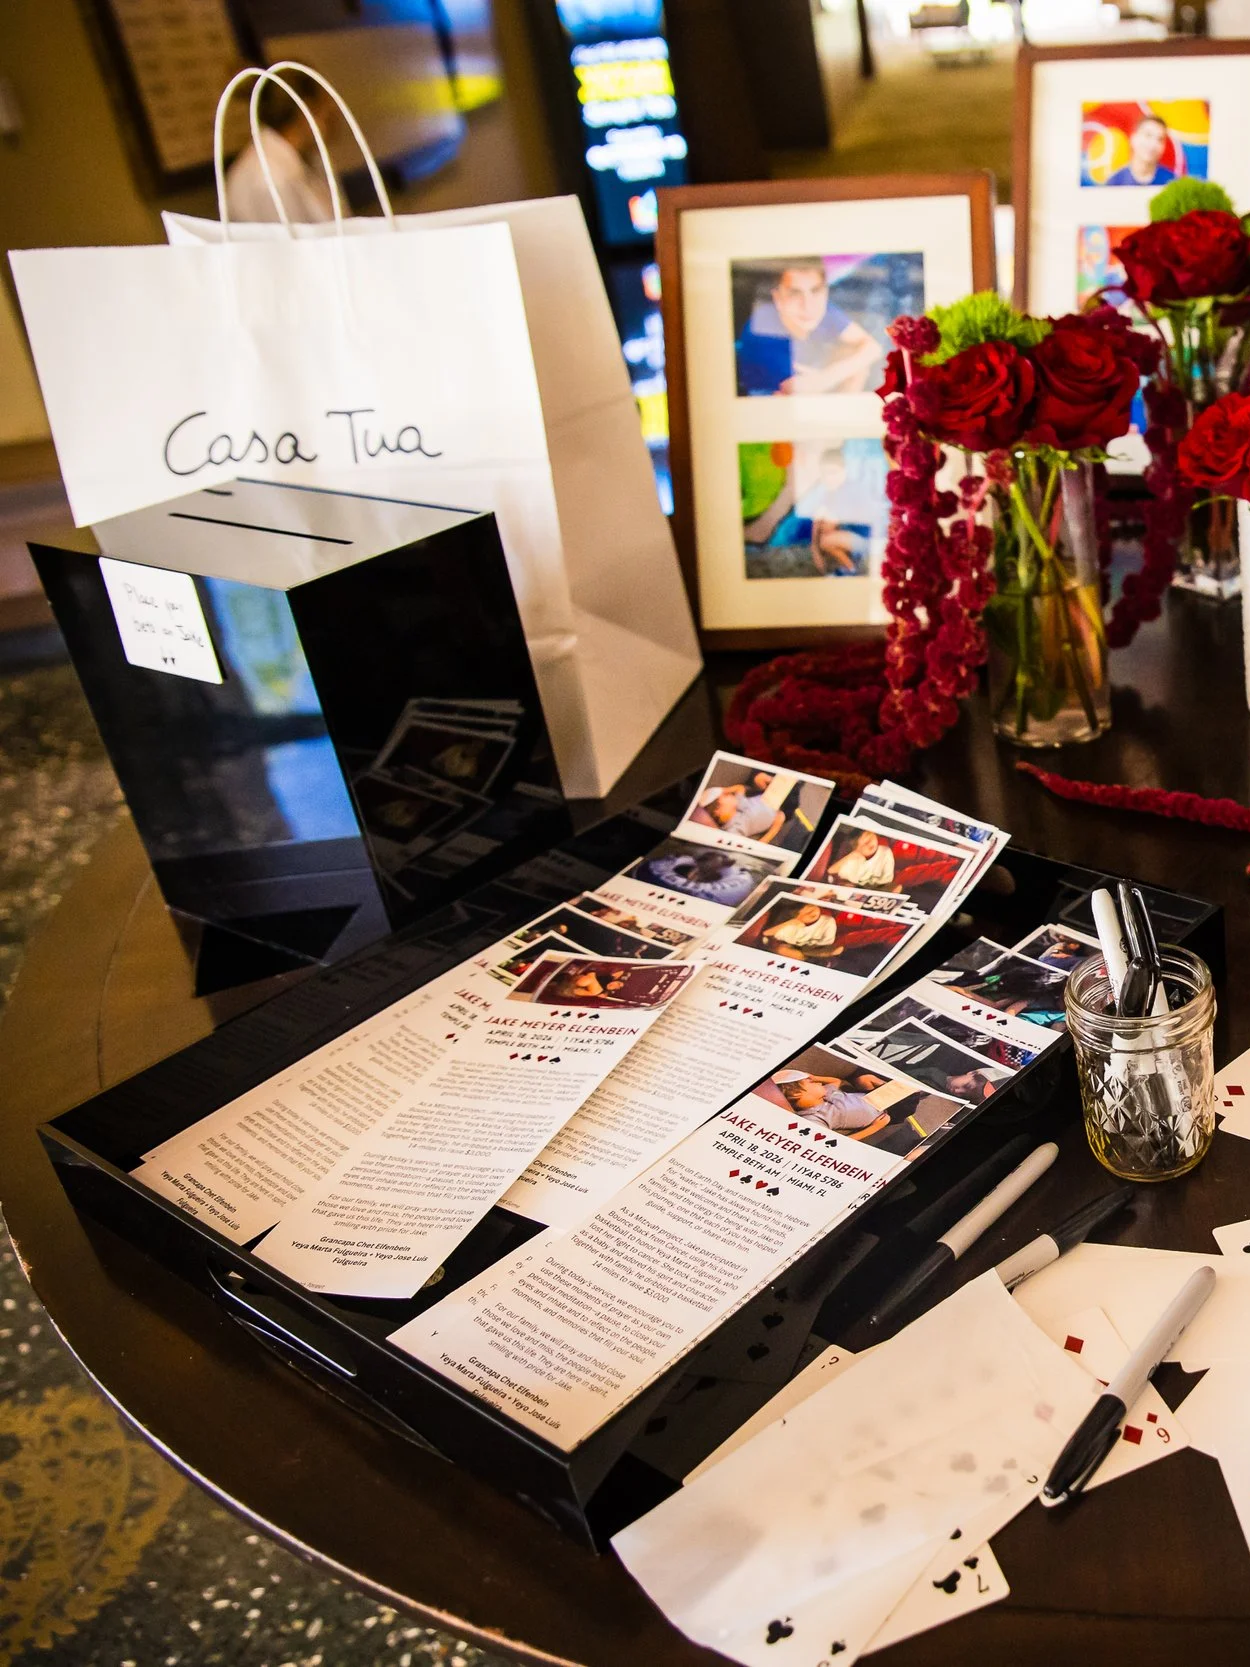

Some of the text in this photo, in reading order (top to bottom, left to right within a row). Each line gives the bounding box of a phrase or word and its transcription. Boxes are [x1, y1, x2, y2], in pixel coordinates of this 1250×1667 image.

[164, 409, 442, 475] Casa Tua
[708, 961, 843, 1002] JAKE MEYER ELFENBEIN
[483, 1016, 638, 1035] JAKE MEYER ELFENBEIN
[712, 1140, 826, 1197] TEMPLE BETH AM MIAMI, FL
[718, 1130, 746, 1146] APRIL
[746, 1142, 758, 1154] 18,
[759, 1149, 783, 1163] 2026
[796, 1166, 821, 1180] IYAR
[819, 1175, 843, 1188] 5786
[719, 1110, 872, 1181] JAKE MEYER ELFENBEIN
[668, 1157, 685, 1169] Born
[693, 1171, 712, 1183] Earth
[710, 1180, 724, 1190] Day
[724, 1188, 739, 1196] and
[737, 1194, 762, 1206] named
[783, 1213, 809, 1227] Hebrew
[291, 1240, 309, 1249] Yeya
[309, 1244, 332, 1252] Marta
[332, 1247, 368, 1257] Fulgueira
[374, 1252, 393, 1260] Yeyo
[319, 1236, 355, 1246] Grancapa
[374, 1242, 410, 1251] Elfenbein
[332, 1256, 367, 1266] Fulgueira
[545, 1256, 569, 1274] During
[590, 1284, 616, 1301] service,
[616, 1298, 628, 1306] we
[626, 1303, 662, 1323] encourage
[660, 1321, 675, 1330] you
[674, 1326, 684, 1334] to
[439, 1352, 560, 1429] Yeya Marta Fulgueira Yeyo Jose Luis
[468, 1356, 549, 1407] Grancapa Chet Elfenbein
[977, 1575, 990, 1593] 7
